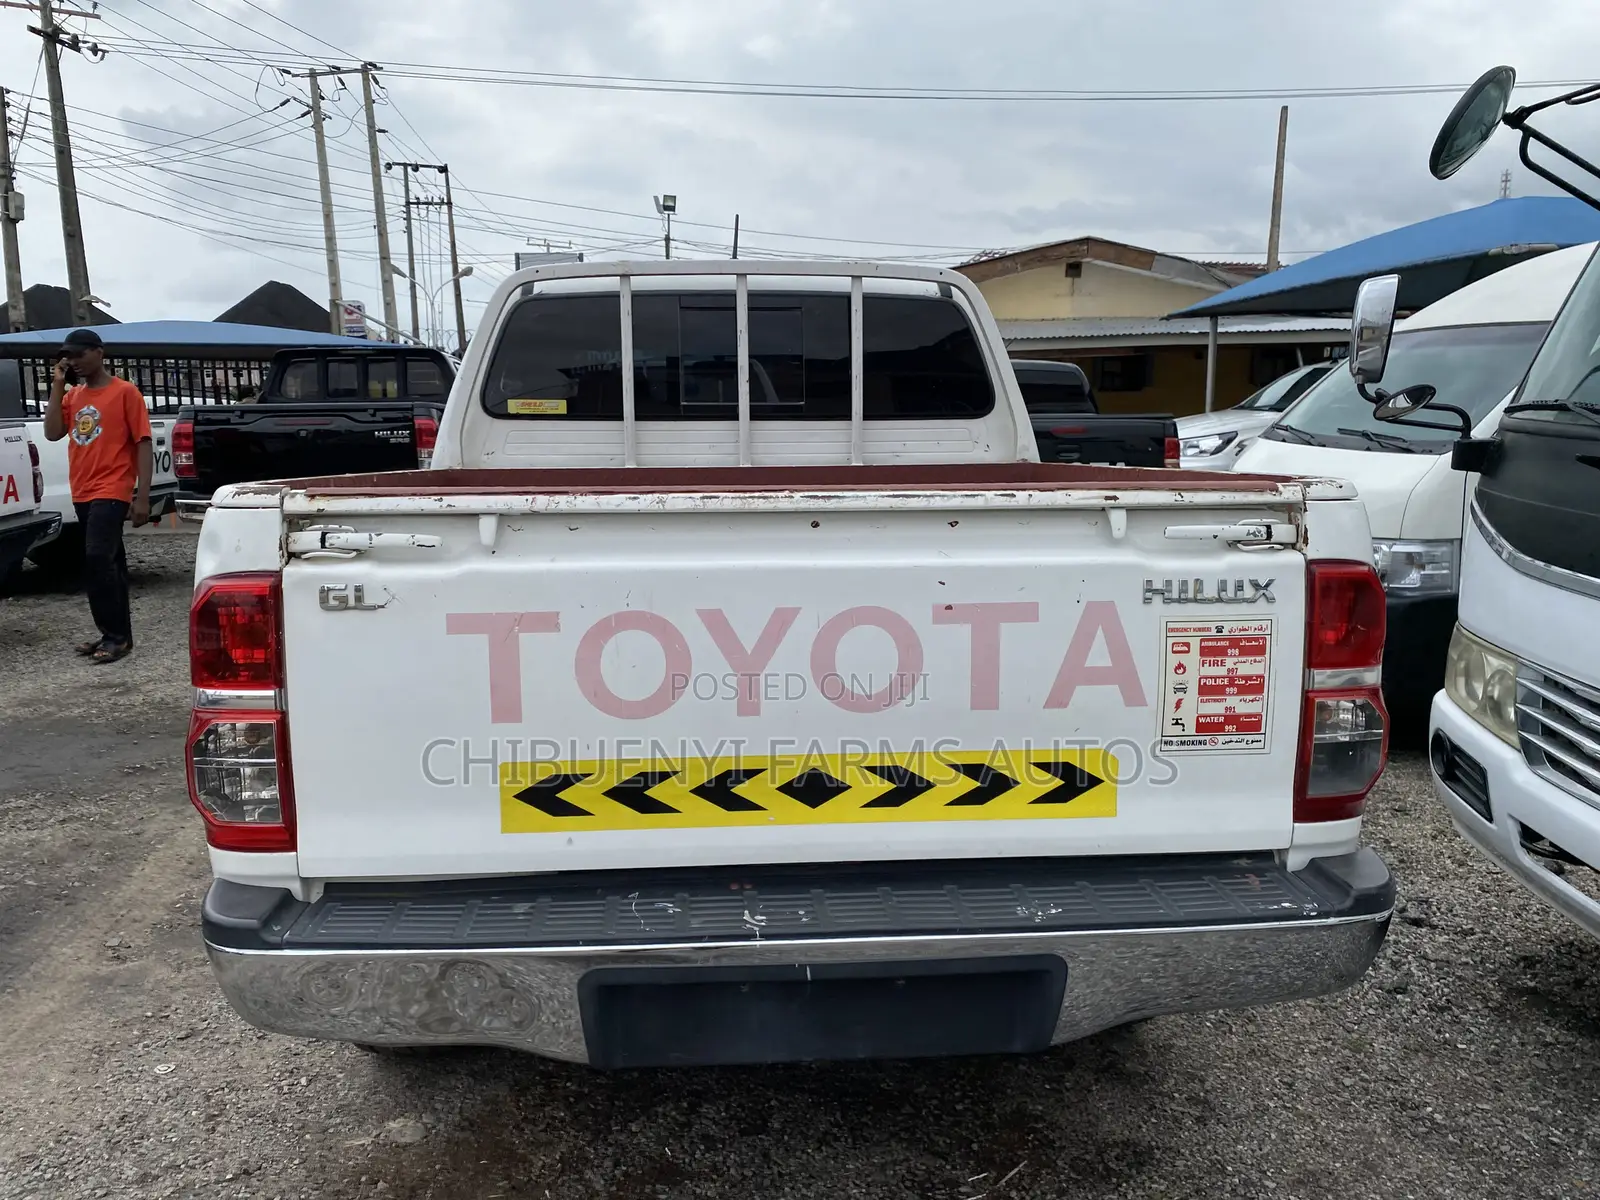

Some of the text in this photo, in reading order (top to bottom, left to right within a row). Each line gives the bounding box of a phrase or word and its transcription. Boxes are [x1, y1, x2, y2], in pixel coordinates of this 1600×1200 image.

[374, 430, 411, 438] HILUX
[4, 435, 24, 443] HILUX
[1143, 578, 1276, 604] HILUX
[319, 583, 379, 611] GL
[1227, 648, 1239, 656] 998
[446, 600, 1148, 724] TOYOTA
[1201, 659, 1227, 667] FIRE
[1226, 667, 1239, 675] 997
[1200, 677, 1230, 686] POLICE
[1225, 687, 1238, 695] 999
[1224, 724, 1237, 732] 992
[1175, 739, 1208, 747] SMOKING
